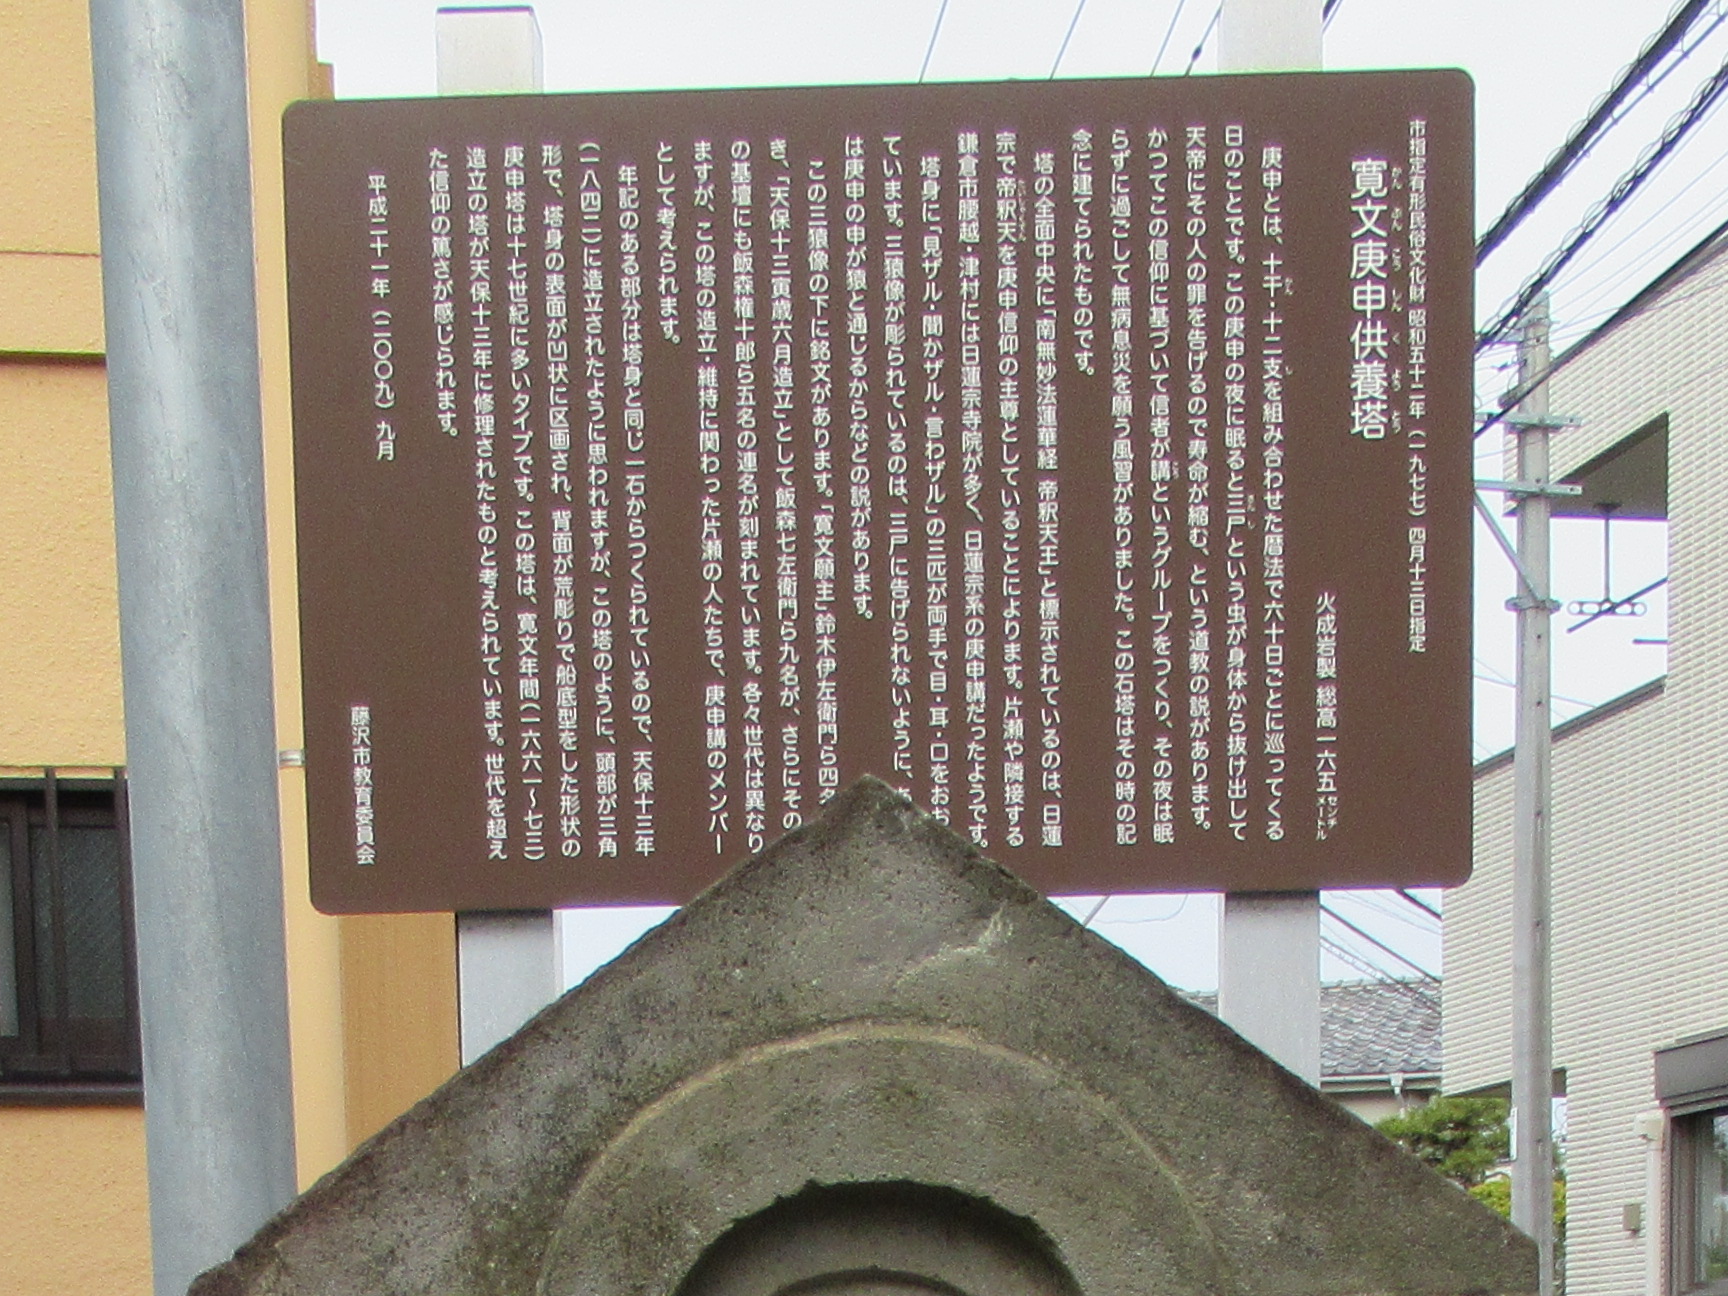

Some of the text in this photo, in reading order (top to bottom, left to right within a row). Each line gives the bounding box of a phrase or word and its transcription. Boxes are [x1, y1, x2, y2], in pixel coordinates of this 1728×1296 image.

[429, 148, 457, 436] た信仰の篤さが感じられます。
[657, 142, 680, 343] として考えられます。
[1072, 128, 1094, 375] 念に建てられたものです。
[1350, 157, 1388, 439] 寛文庚申供養塔
[351, 706, 375, 864] 藤沢市教育委員会
